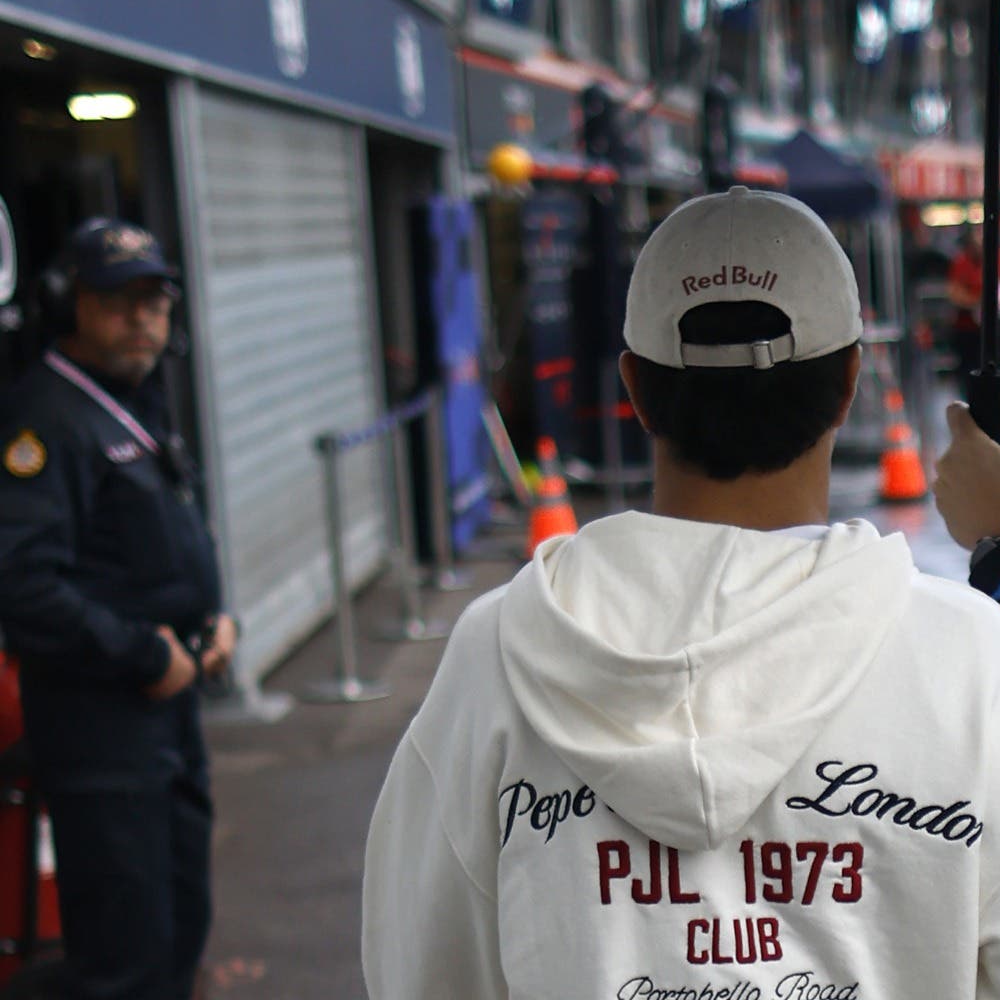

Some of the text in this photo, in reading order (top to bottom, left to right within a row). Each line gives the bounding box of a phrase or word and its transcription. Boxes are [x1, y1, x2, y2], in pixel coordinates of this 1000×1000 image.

[682, 265, 778, 296] Red Bull
[597, 838, 864, 905] PJL 1973
[686, 917, 783, 965] CLUB
